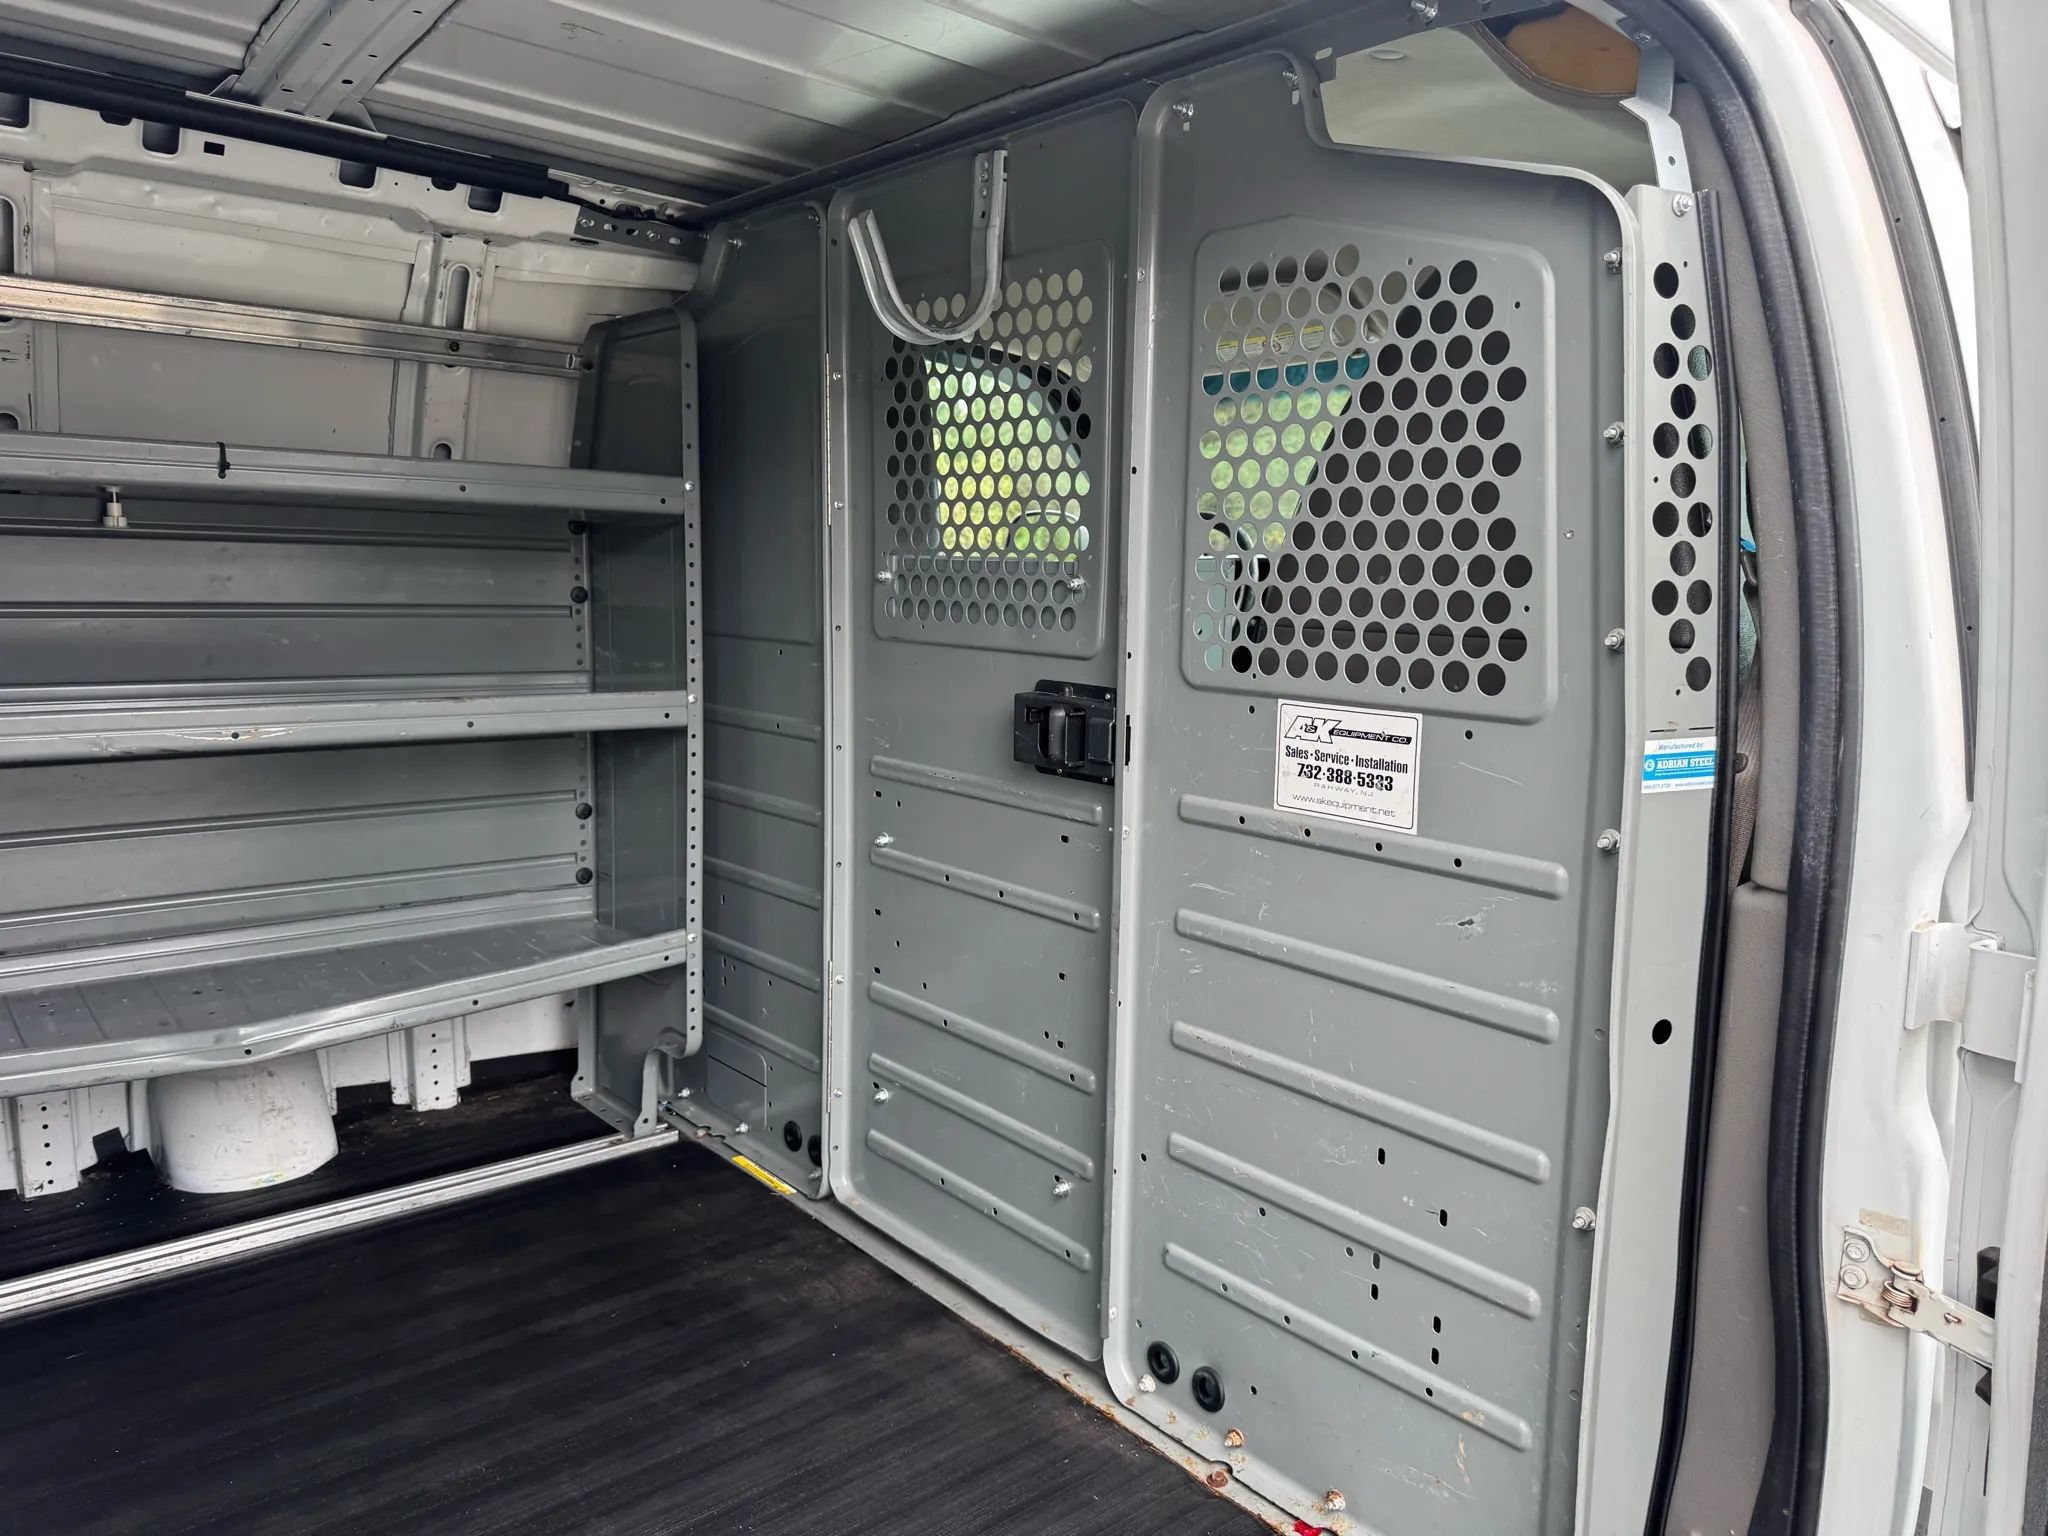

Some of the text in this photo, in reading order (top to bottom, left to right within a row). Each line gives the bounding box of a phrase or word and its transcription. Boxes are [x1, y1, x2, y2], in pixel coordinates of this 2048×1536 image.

[1332, 729, 1391, 742] EQUIPMENT
[1391, 736, 1409, 744] CO.
[1658, 743, 1696, 751] Manufactured
[1285, 744, 1408, 774] Sales Service Installation
[1656, 757, 1715, 770] ADRIAN STEEL
